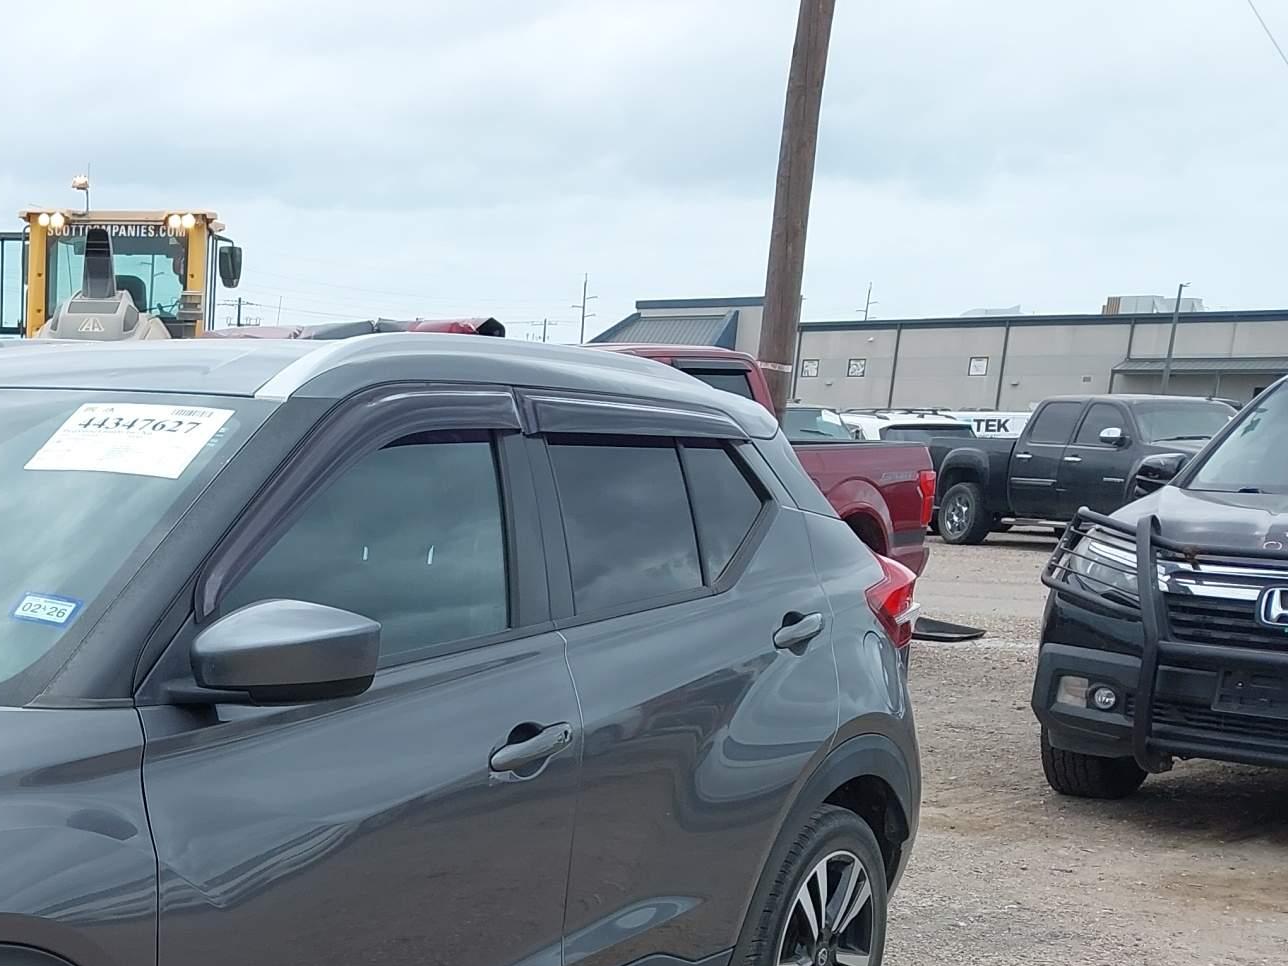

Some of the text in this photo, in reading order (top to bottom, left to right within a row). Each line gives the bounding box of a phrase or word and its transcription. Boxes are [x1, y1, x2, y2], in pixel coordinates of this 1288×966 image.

[78, 417, 202, 433] 44347627
[973, 418, 1010, 433] TEK
[22, 602, 42, 614] 02
[46, 606, 67, 618] 26
